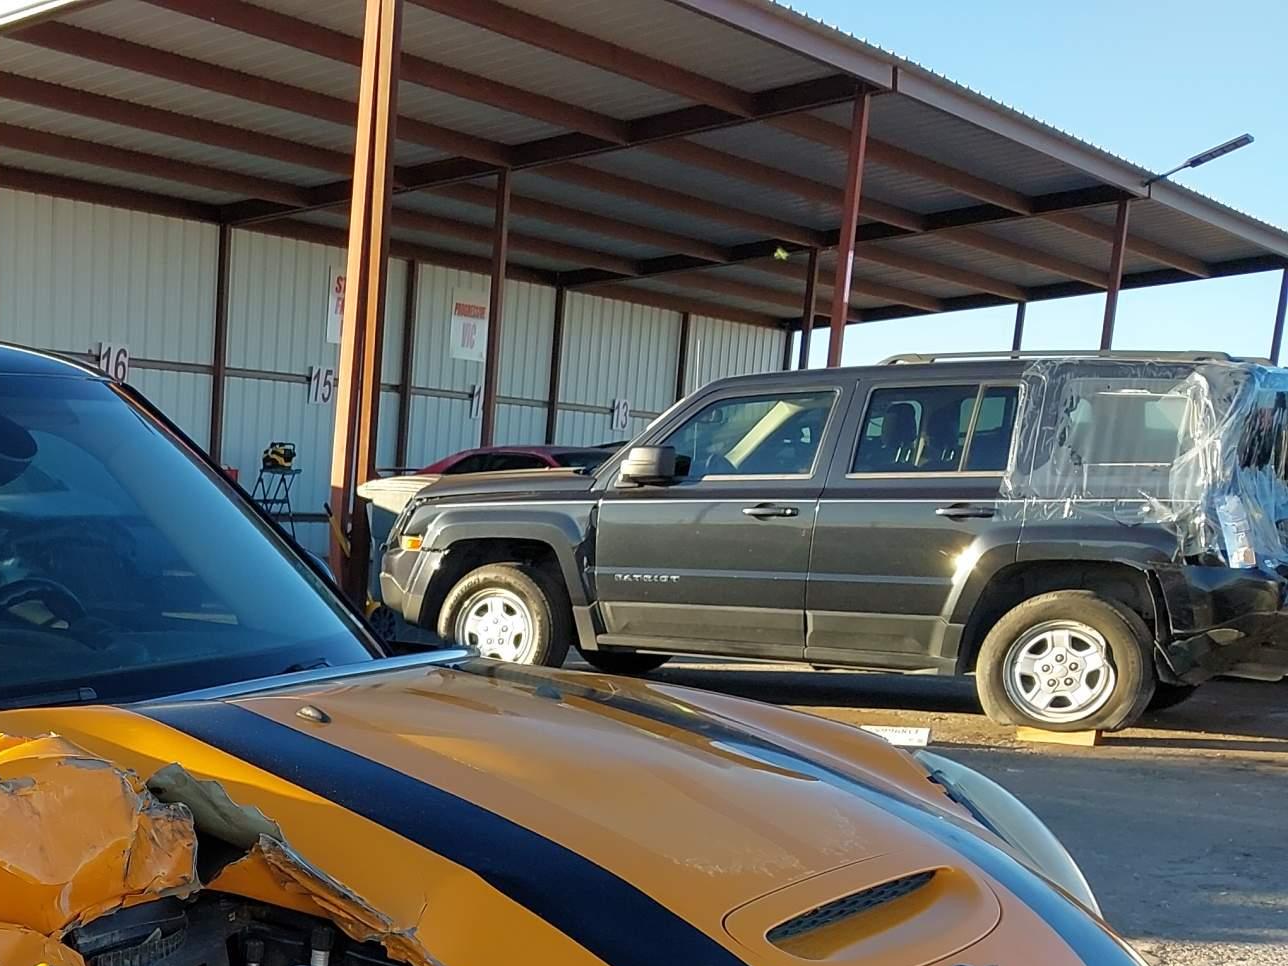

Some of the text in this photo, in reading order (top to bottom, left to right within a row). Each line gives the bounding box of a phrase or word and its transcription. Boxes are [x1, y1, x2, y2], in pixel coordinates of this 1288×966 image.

[102, 346, 127, 381] 16
[313, 367, 333, 403] 15
[474, 385, 482, 417] 1
[615, 401, 629, 429] 13
[614, 573, 680, 583] PATRIOT
